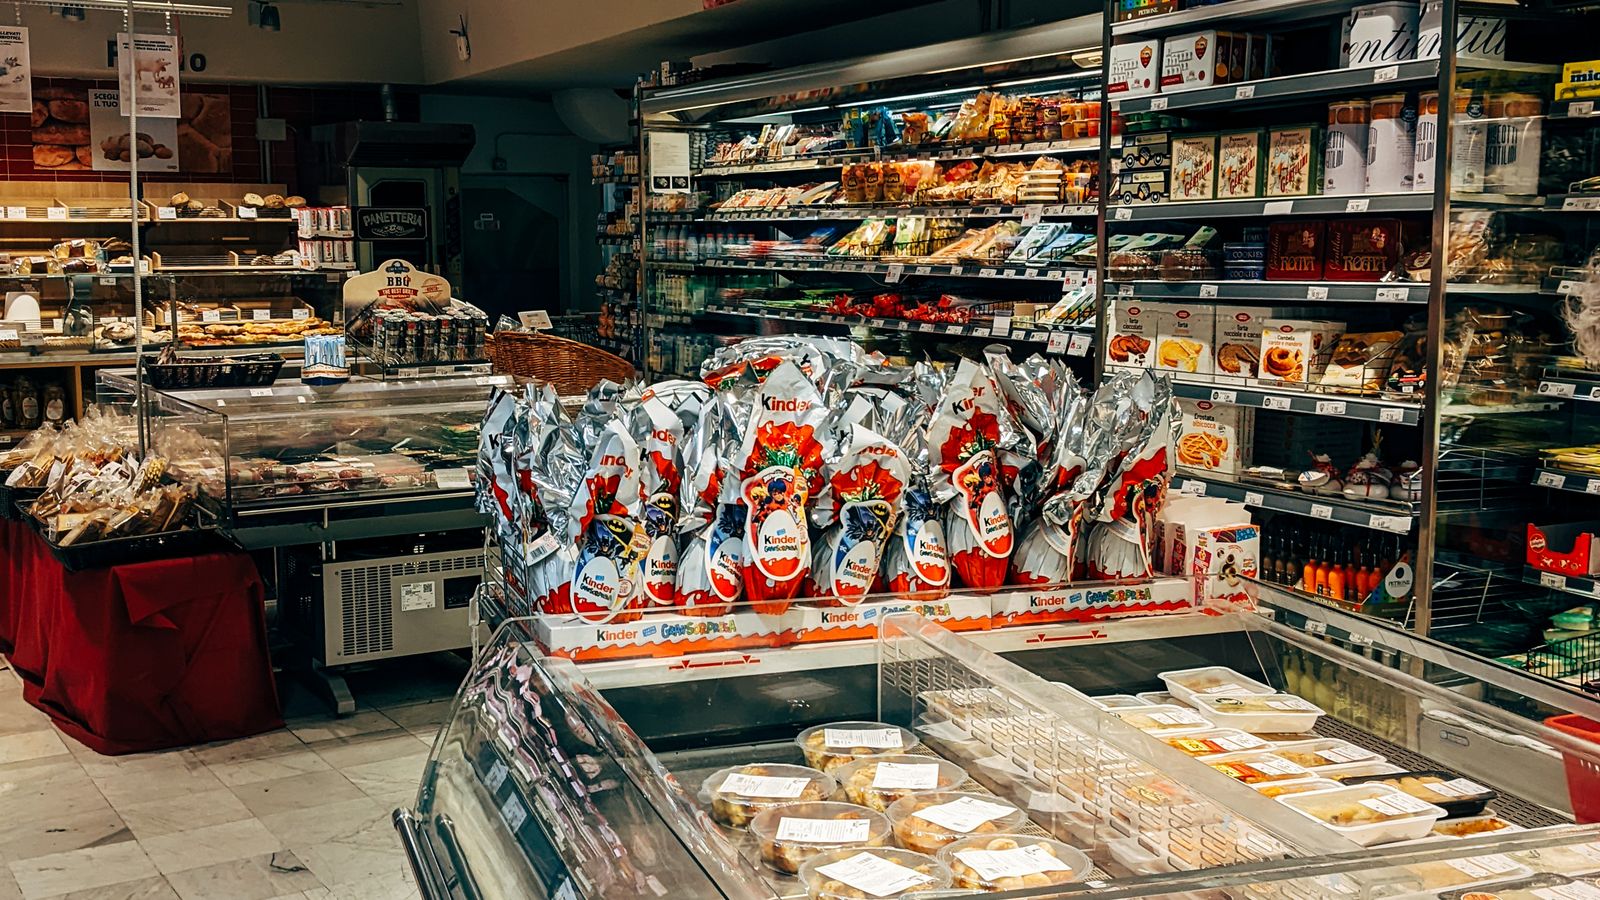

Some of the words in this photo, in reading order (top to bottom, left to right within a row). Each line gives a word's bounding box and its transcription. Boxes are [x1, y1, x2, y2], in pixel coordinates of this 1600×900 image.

[362, 211, 422, 227] PANETTERIA
[1232, 250, 1263, 259] COOKIES
[1230, 270, 1259, 278] COOKIES
[387, 275, 411, 287] BBQ
[761, 394, 812, 412] Kinder
[1194, 413, 1215, 422] Crostata
[764, 534, 797, 545] Kinder
[845, 559, 872, 574] Kinder
[582, 573, 615, 595] Kinder
[1030, 594, 1067, 607] Kinder
[821, 611, 860, 625] Kinder
[596, 629, 639, 642] Kinder
